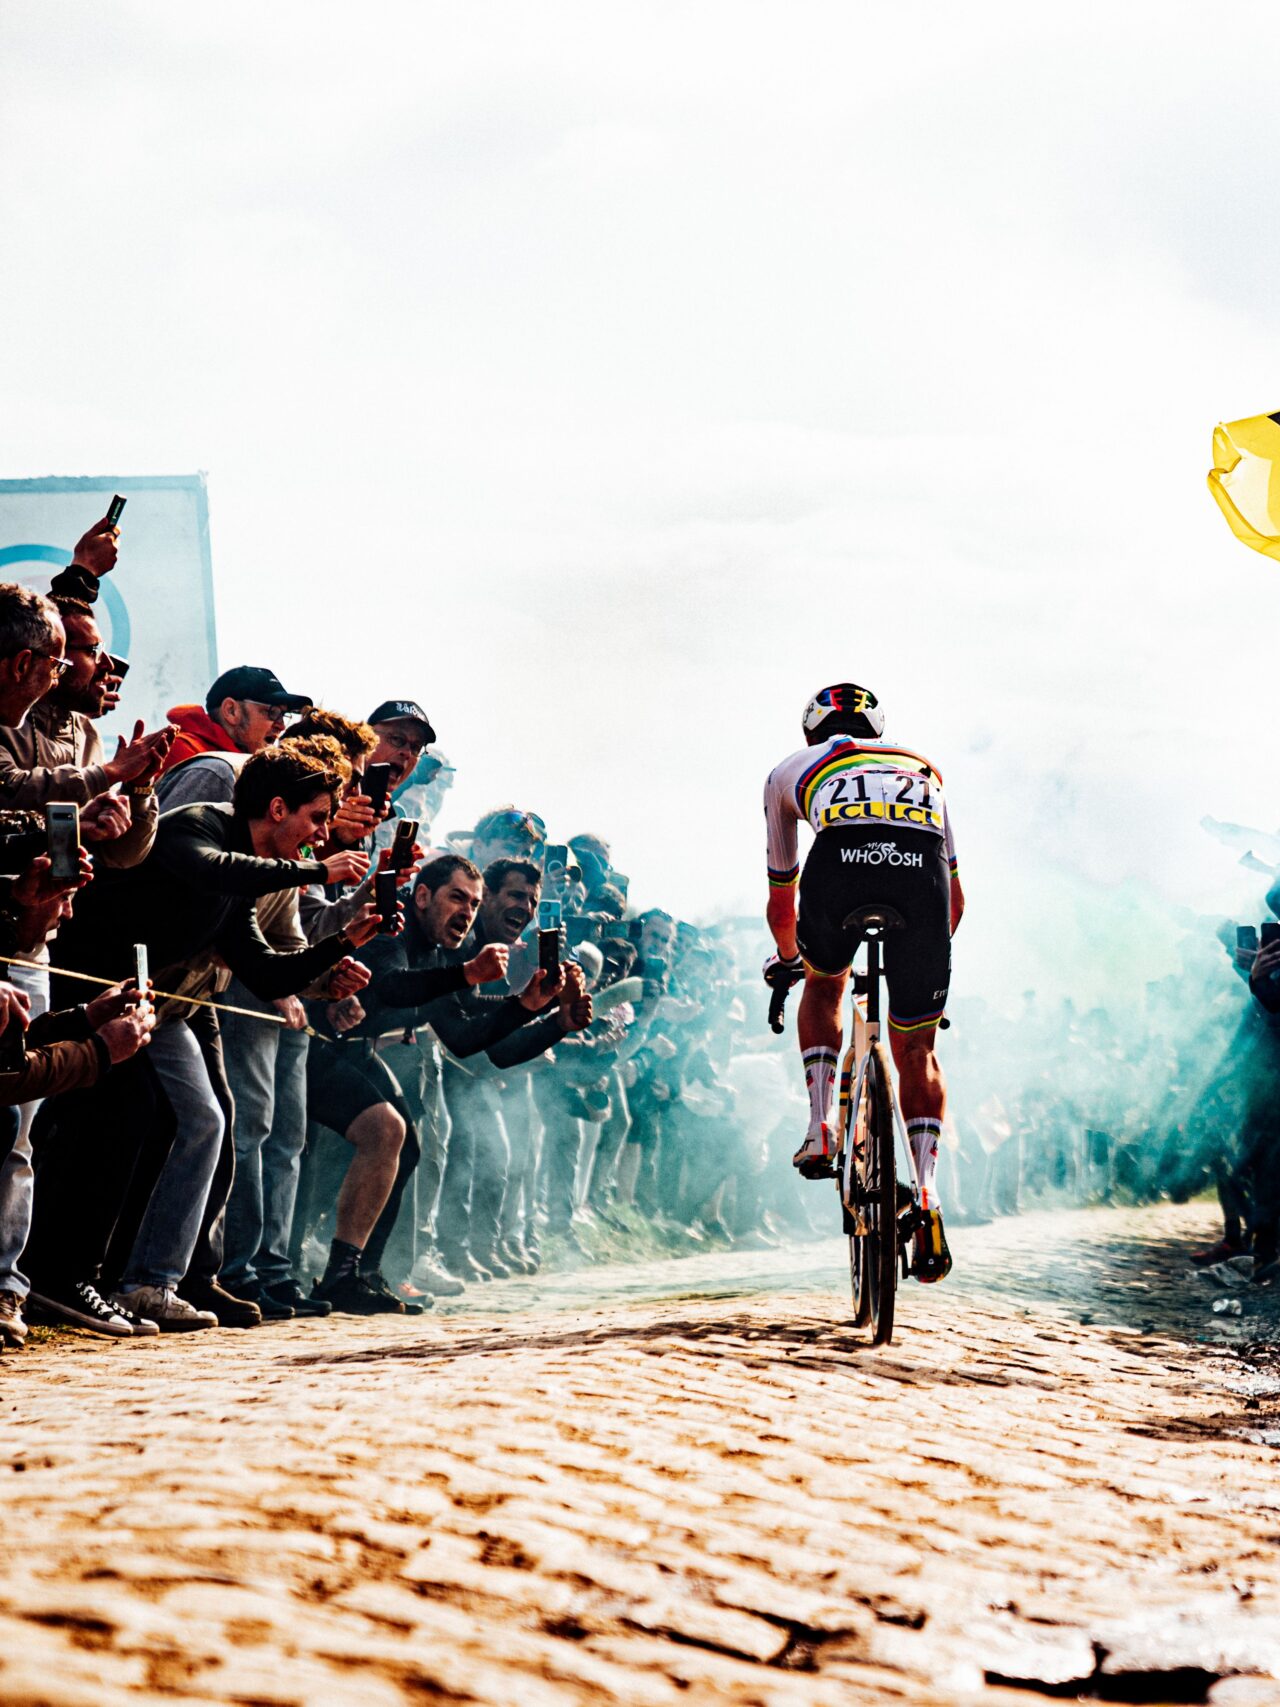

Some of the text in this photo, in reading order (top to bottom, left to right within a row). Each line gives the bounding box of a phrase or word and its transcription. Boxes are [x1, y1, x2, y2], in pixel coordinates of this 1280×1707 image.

[828, 775, 871, 805] 21
[895, 775, 933, 809] 21
[824, 802, 883, 824] LCL
[840, 848, 923, 868] WHOOSH
